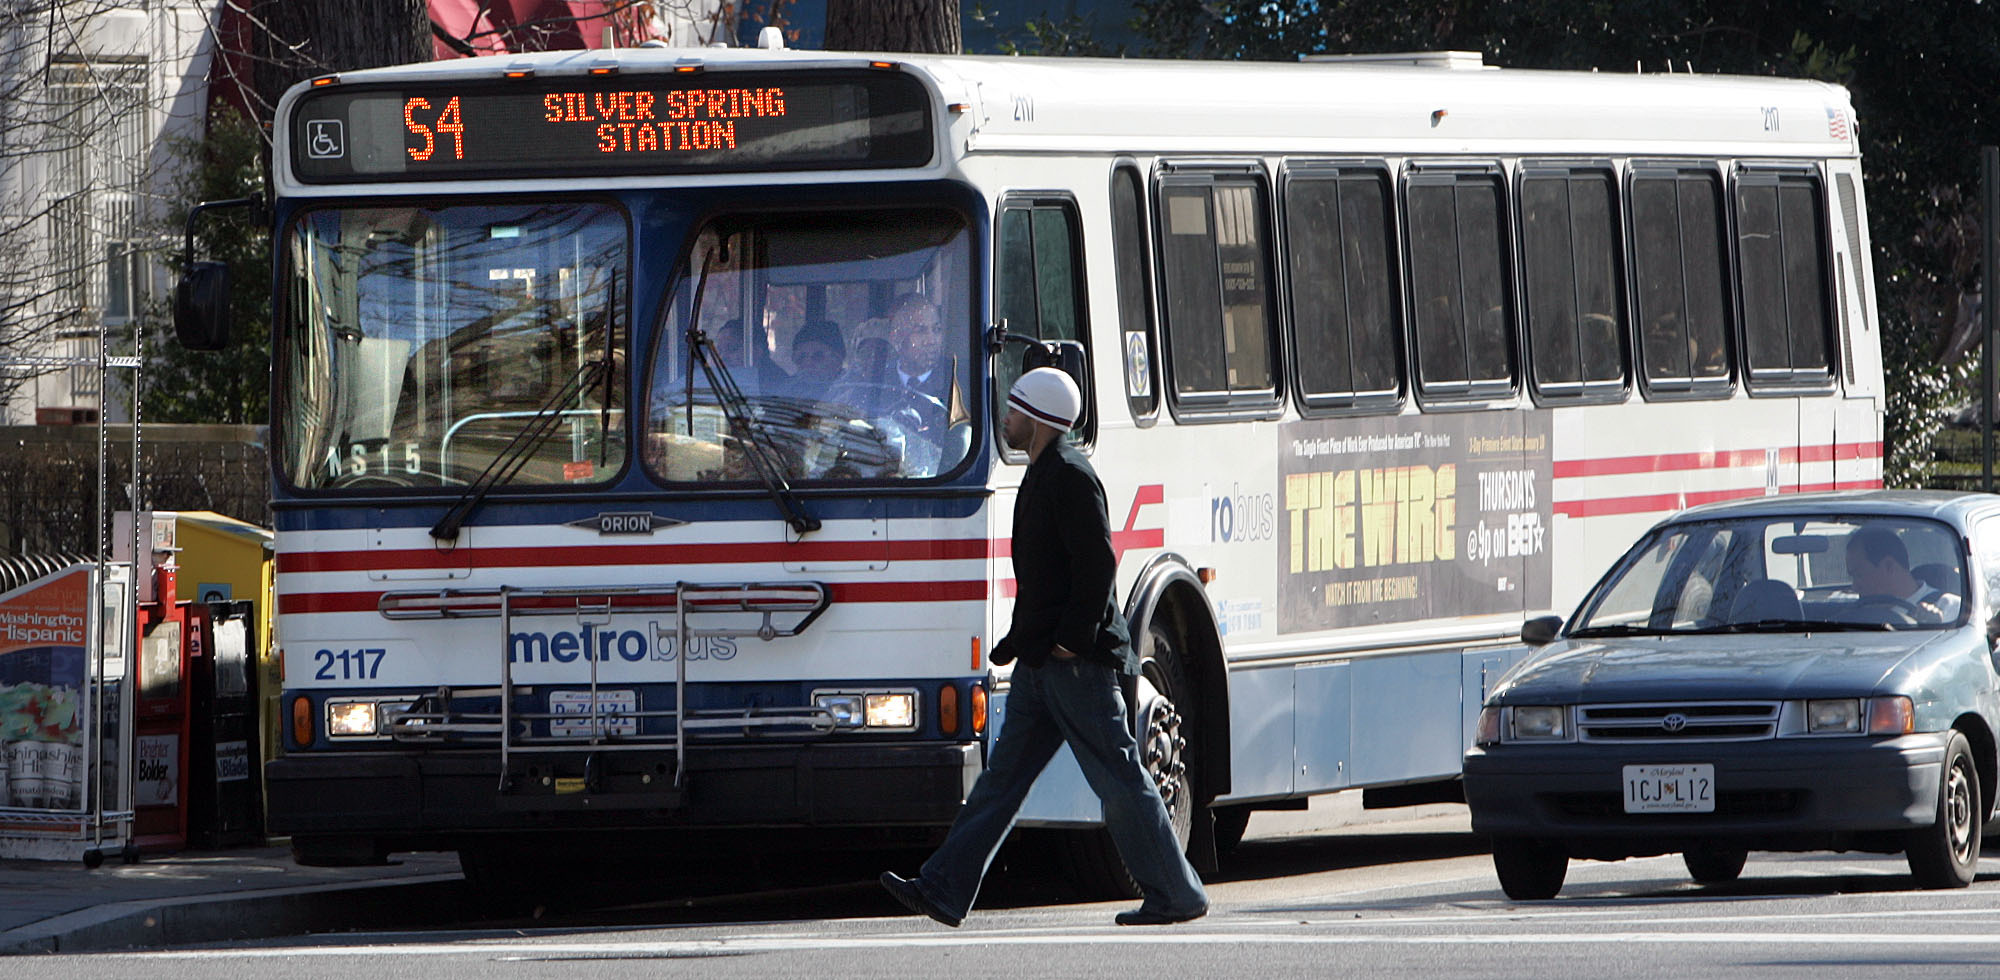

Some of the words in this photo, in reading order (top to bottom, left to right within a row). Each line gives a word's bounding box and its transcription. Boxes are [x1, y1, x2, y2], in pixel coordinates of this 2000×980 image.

[543, 91, 656, 123] SILVER
[667, 87, 786, 119] SPRING
[1009, 93, 1034, 122] 2117
[404, 95, 465, 161] S4
[597, 120, 737, 153] STATION
[1479, 469, 1535, 512] THURSDAYS
[601, 515, 651, 534] ORION
[1286, 471, 1356, 574] THE
[1360, 463, 1456, 567] WIRE
[1493, 528, 1505, 559] on
[1508, 512, 1537, 557] BET
[1325, 581, 1346, 607] WATCH
[1346, 581, 1352, 605] IT
[1353, 579, 1371, 604] FROM
[1372, 578, 1383, 603] THE
[1384, 575, 1418, 602] BEGINNING!
[510, 621, 738, 663] metrobus
[314, 648, 387, 681] 2117
[139, 759, 169, 781] Bolder
[1650, 767, 1685, 778] Maryland
[1630, 779, 1662, 802] 1CJ
[1675, 778, 1710, 801] L12
